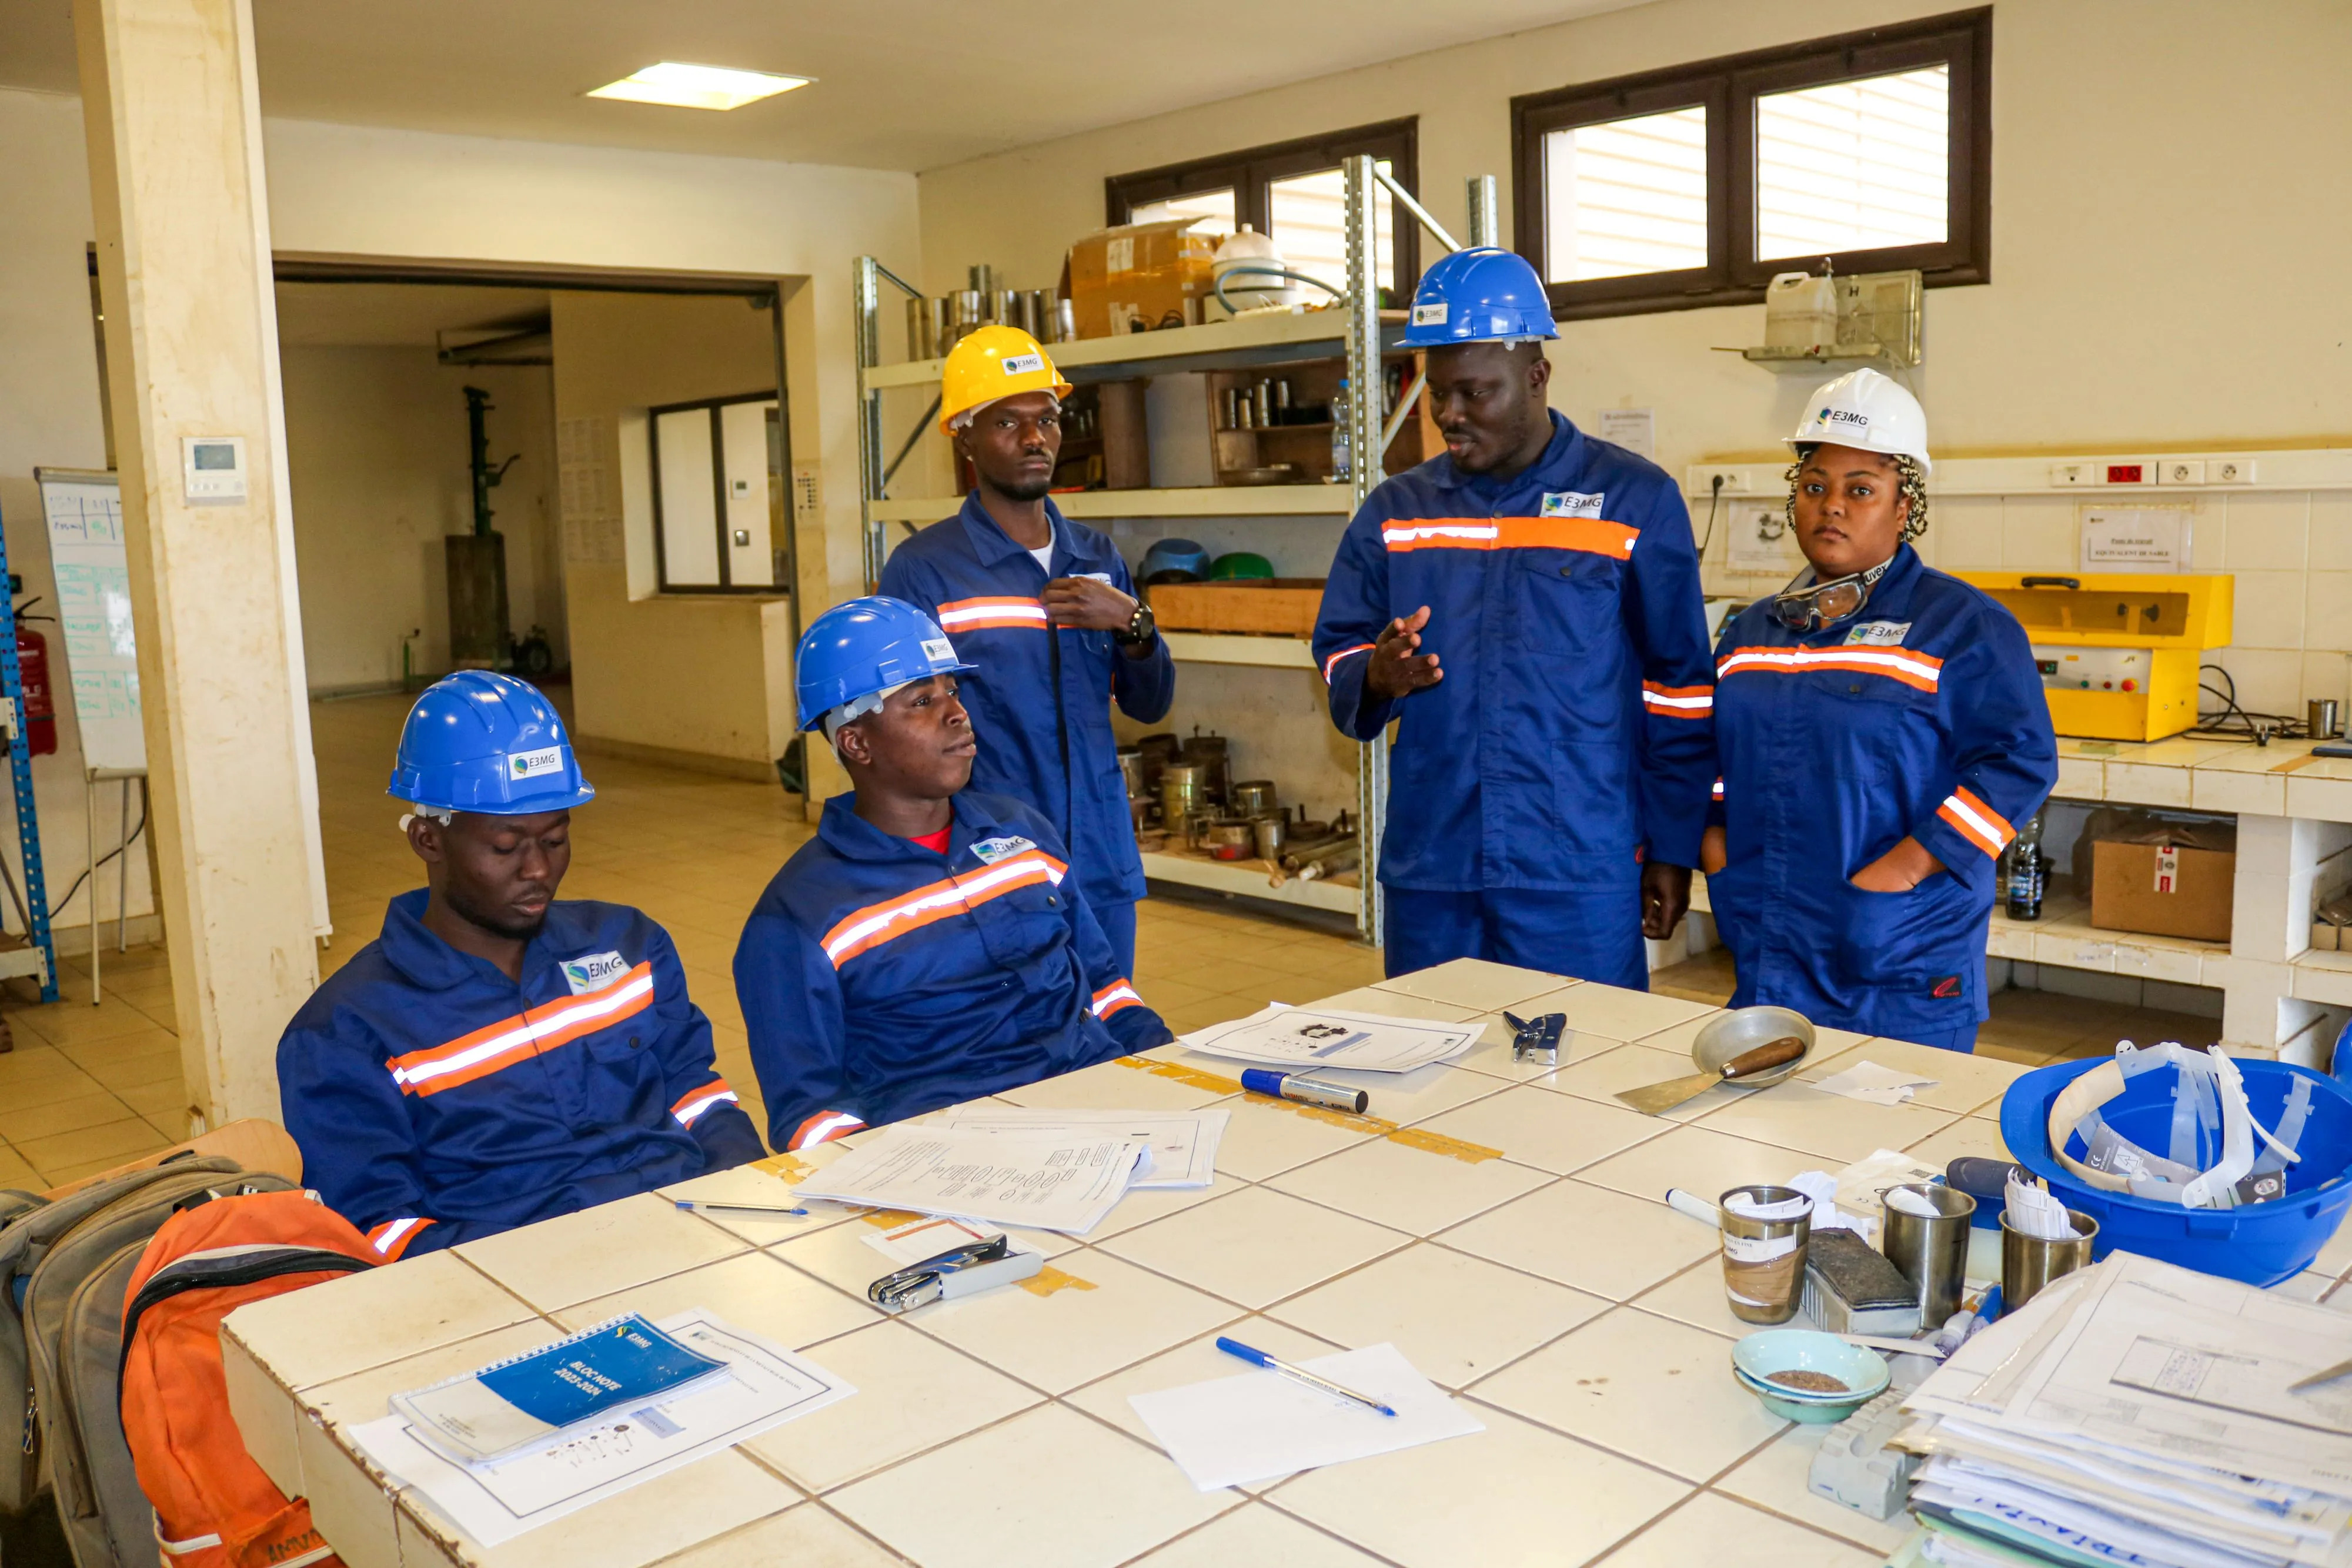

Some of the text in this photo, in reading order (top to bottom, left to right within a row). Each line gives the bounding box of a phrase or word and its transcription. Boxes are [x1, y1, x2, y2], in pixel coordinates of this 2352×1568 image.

[1017, 358, 1038, 367] E3MG
[1832, 410, 1868, 426] E3MG
[1564, 496, 1602, 509] E3MG
[1865, 563, 1887, 583] uvex
[1868, 626, 1907, 637] E3MG
[529, 754, 555, 767] E3MG
[994, 837, 1025, 853] E3MG
[589, 957, 622, 977] E3MG
[626, 1332, 652, 1349] E3MG
[553, 1368, 603, 1396] 2023-2024
[569, 1361, 622, 1391] BLOC NOTE
